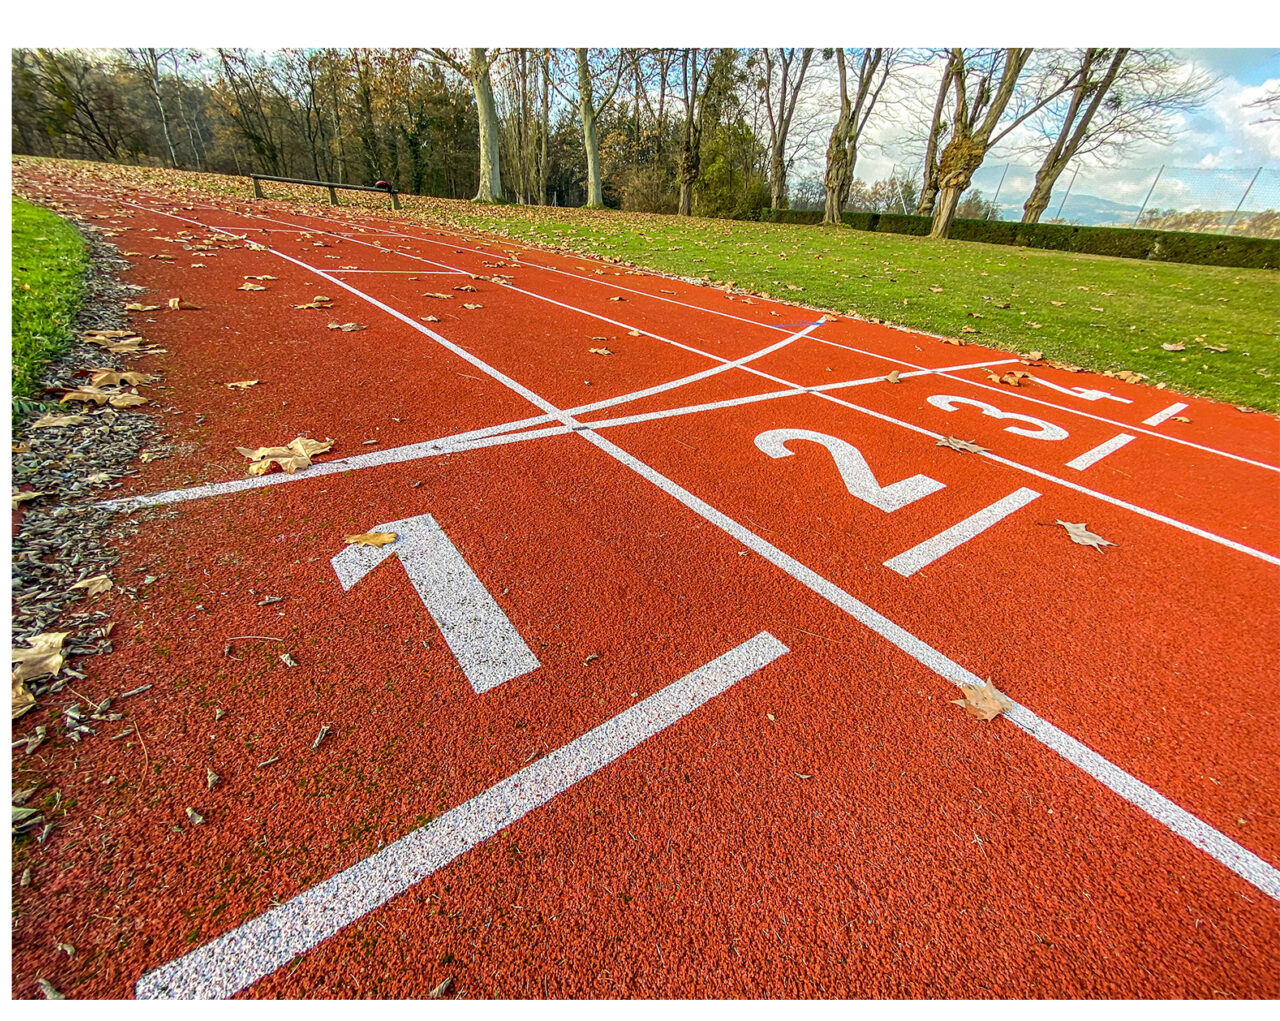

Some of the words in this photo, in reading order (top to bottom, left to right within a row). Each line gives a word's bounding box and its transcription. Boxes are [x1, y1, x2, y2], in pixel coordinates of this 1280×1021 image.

[926, 394, 1070, 441] 3
[753, 428, 947, 513] 2
[330, 513, 541, 694] 1
